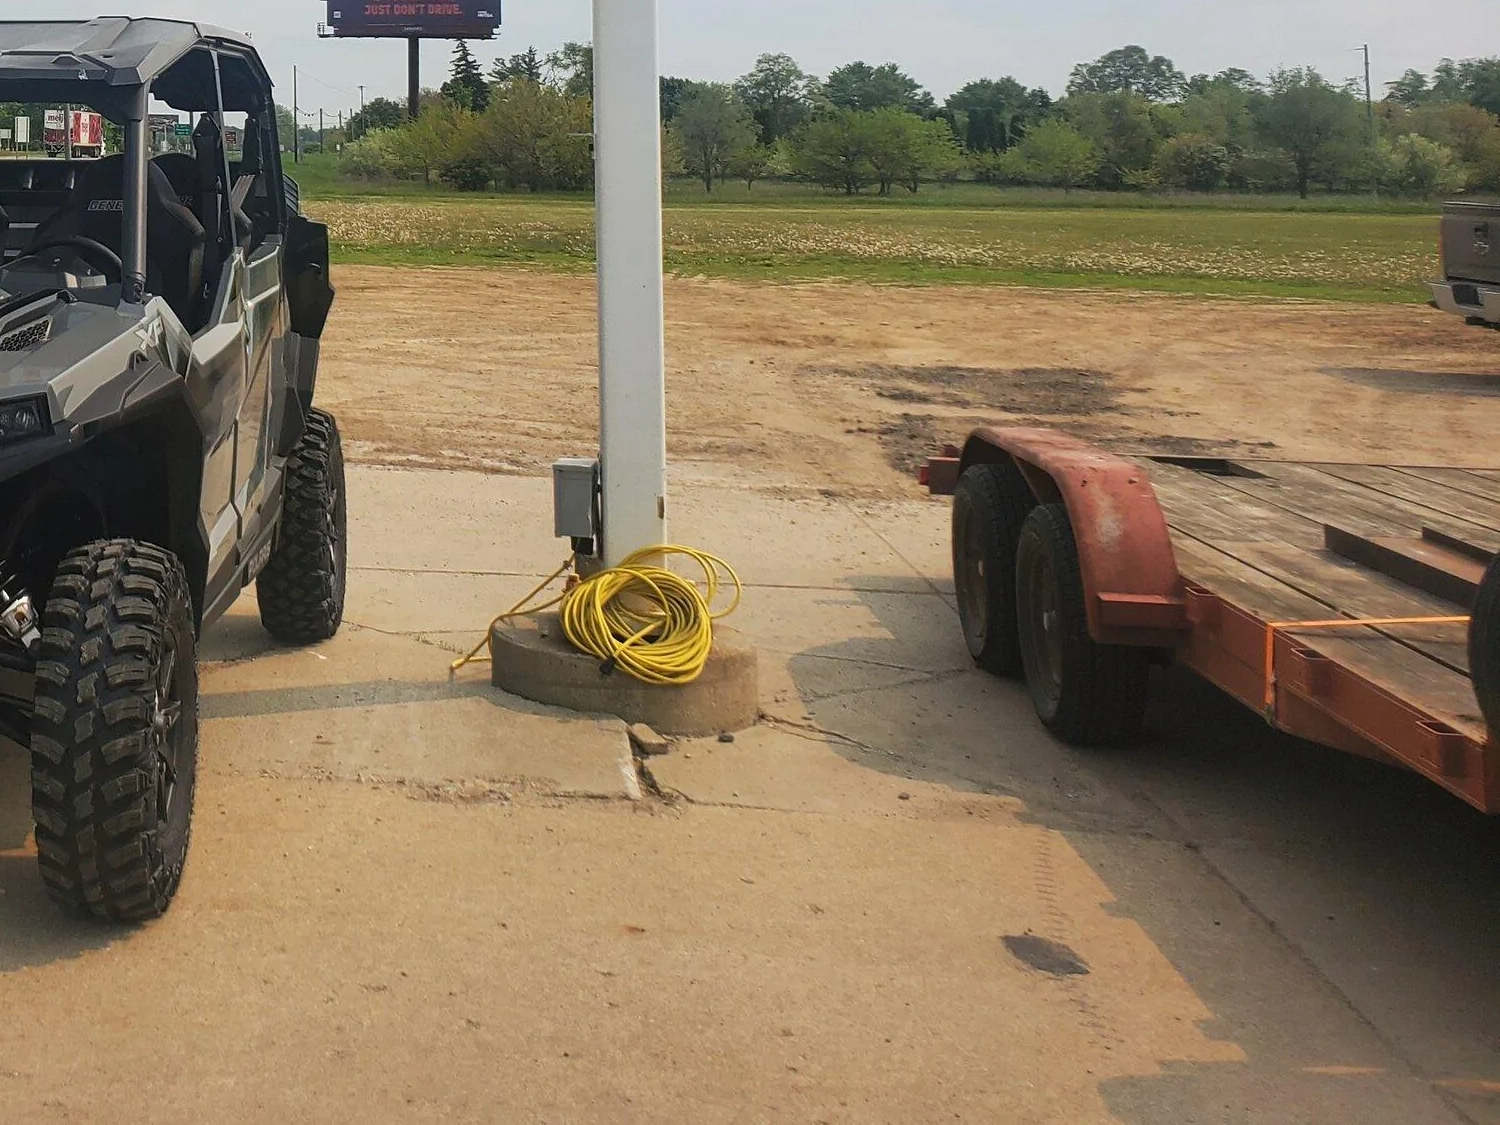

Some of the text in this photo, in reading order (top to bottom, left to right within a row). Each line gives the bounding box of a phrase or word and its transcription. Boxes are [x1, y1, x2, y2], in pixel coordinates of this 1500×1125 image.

[364, 4, 391, 15] JUST
[393, 4, 425, 15] DON'T
[427, 4, 463, 15] DRIVE.
[87, 199, 123, 211] GENE
